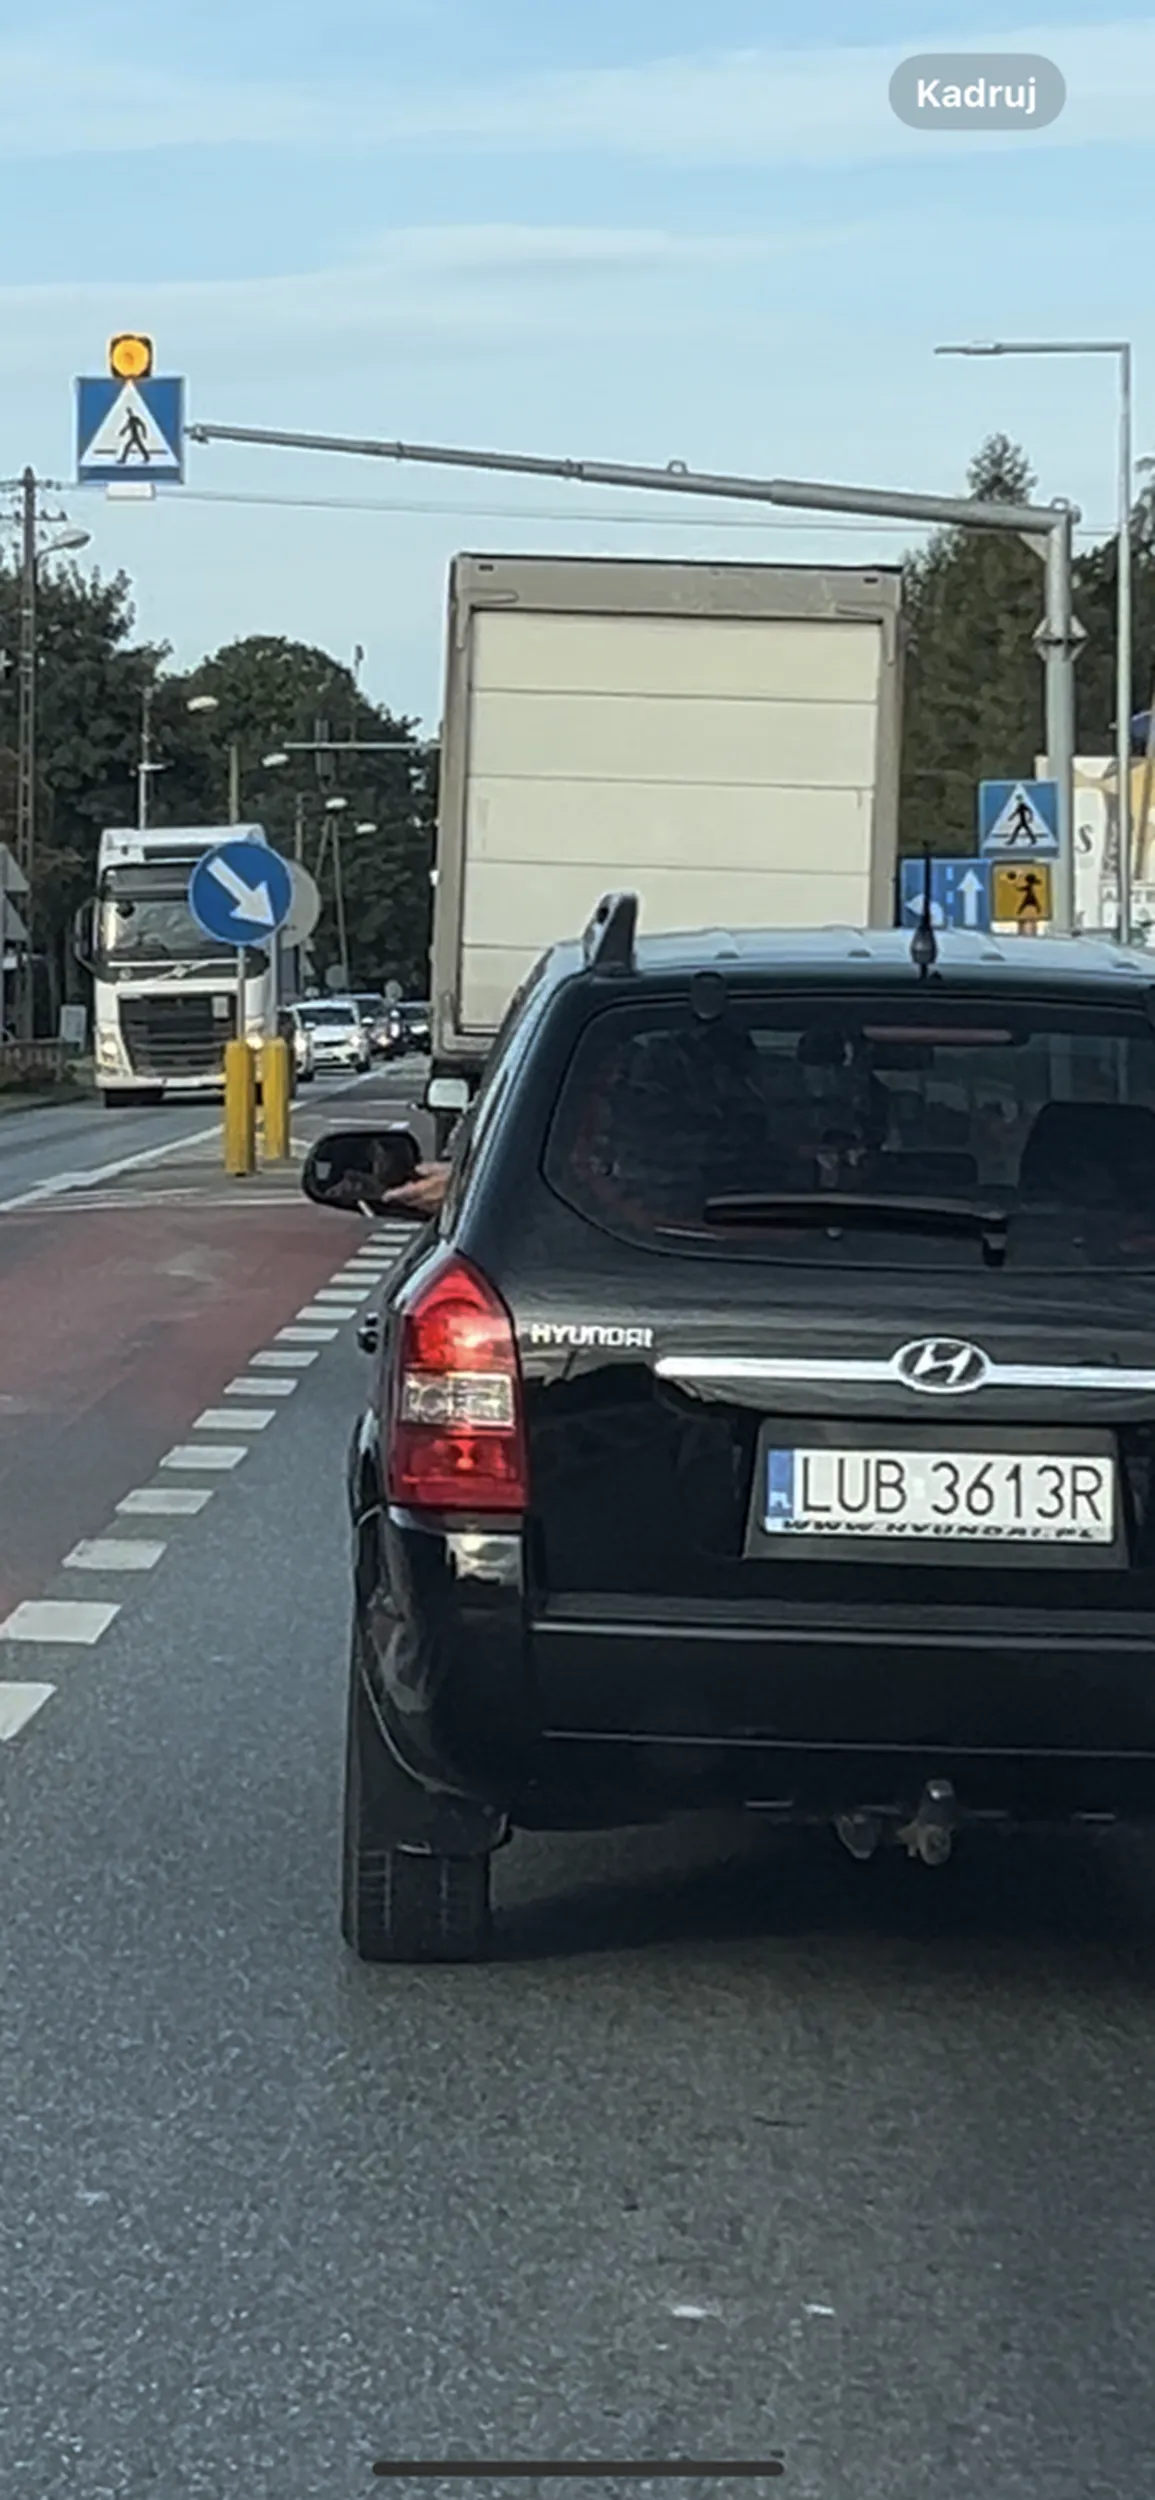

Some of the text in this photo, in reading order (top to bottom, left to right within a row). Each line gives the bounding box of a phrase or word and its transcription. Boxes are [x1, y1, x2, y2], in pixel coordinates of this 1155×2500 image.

[530, 1323, 654, 1348] HYUNDAI
[803, 1457, 1102, 1521] LUB 3613R
